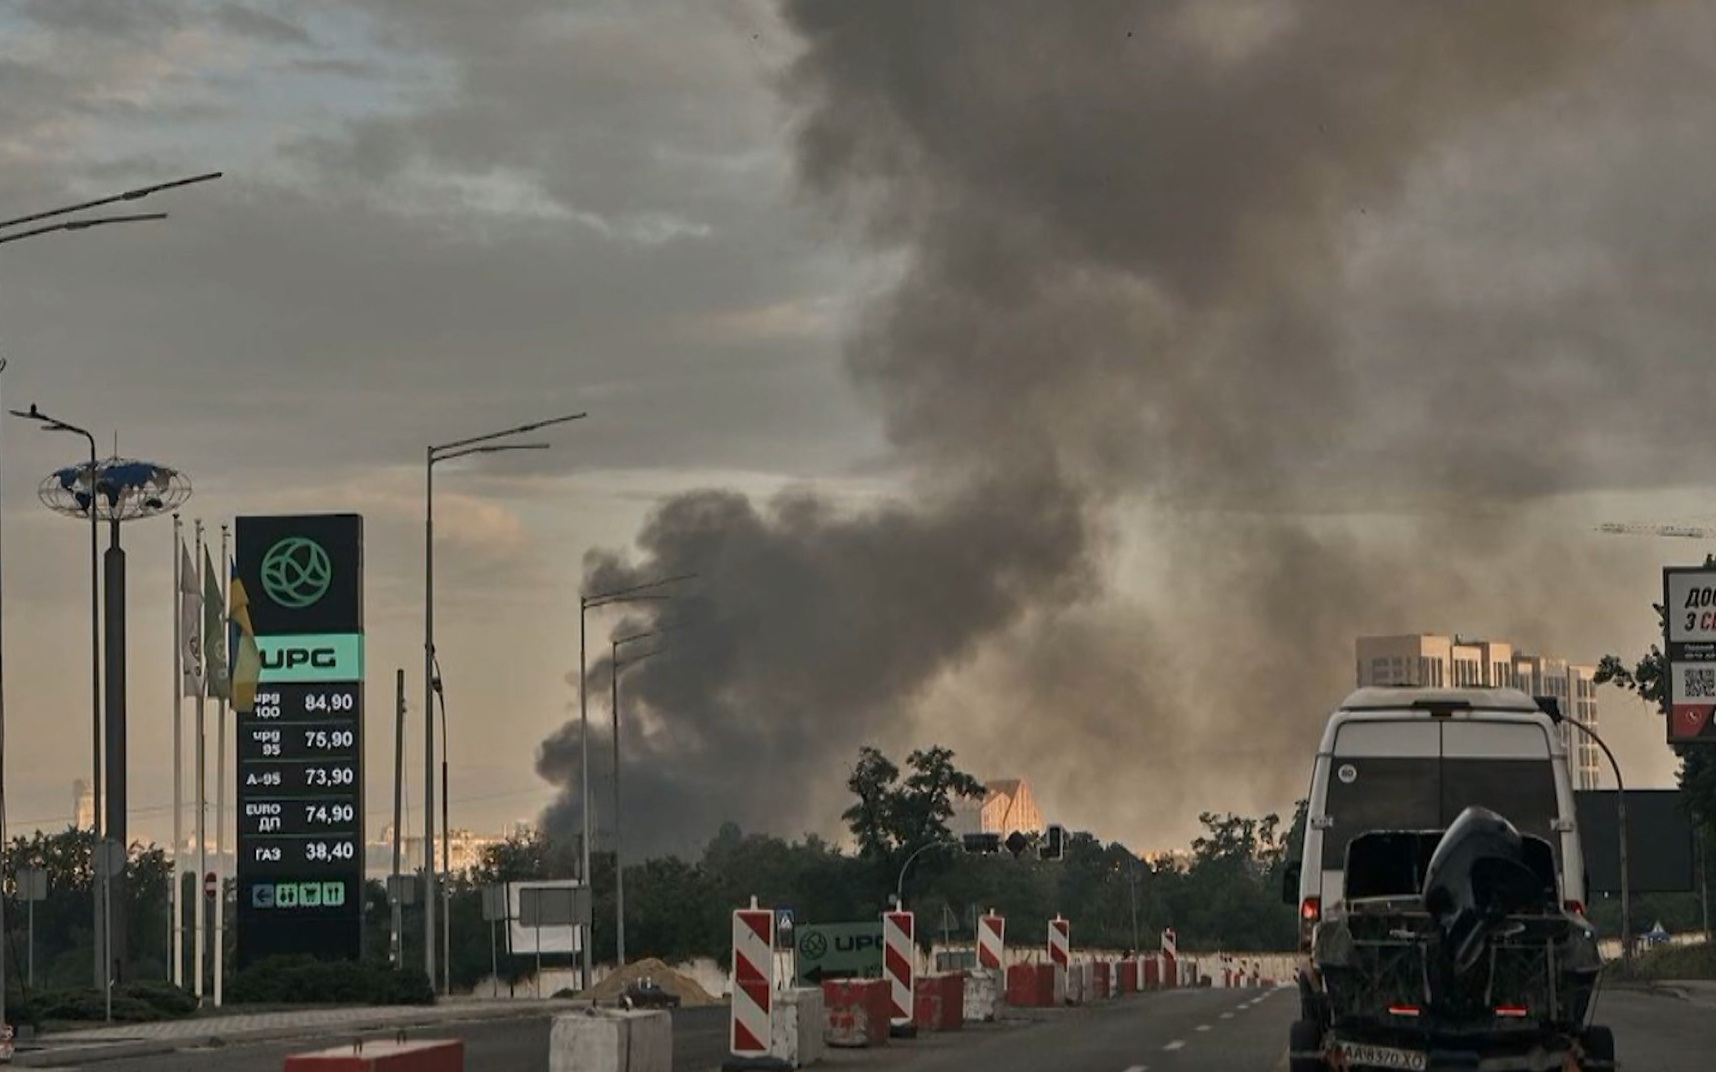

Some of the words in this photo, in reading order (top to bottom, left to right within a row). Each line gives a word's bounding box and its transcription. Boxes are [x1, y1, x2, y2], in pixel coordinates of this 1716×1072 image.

[260, 648, 336, 669] UPG
[255, 706, 280, 718] 100
[304, 693, 353, 713] 84,90
[252, 731, 281, 743] upg
[304, 731, 353, 750] 75,90
[262, 744, 281, 756] 95
[304, 767, 354, 787] 73,90
[246, 803, 281, 815] EURO
[304, 804, 354, 824] 74,90
[258, 817, 281, 832] ДП
[255, 847, 281, 861] ГАЗ
[304, 841, 354, 863] 38,40
